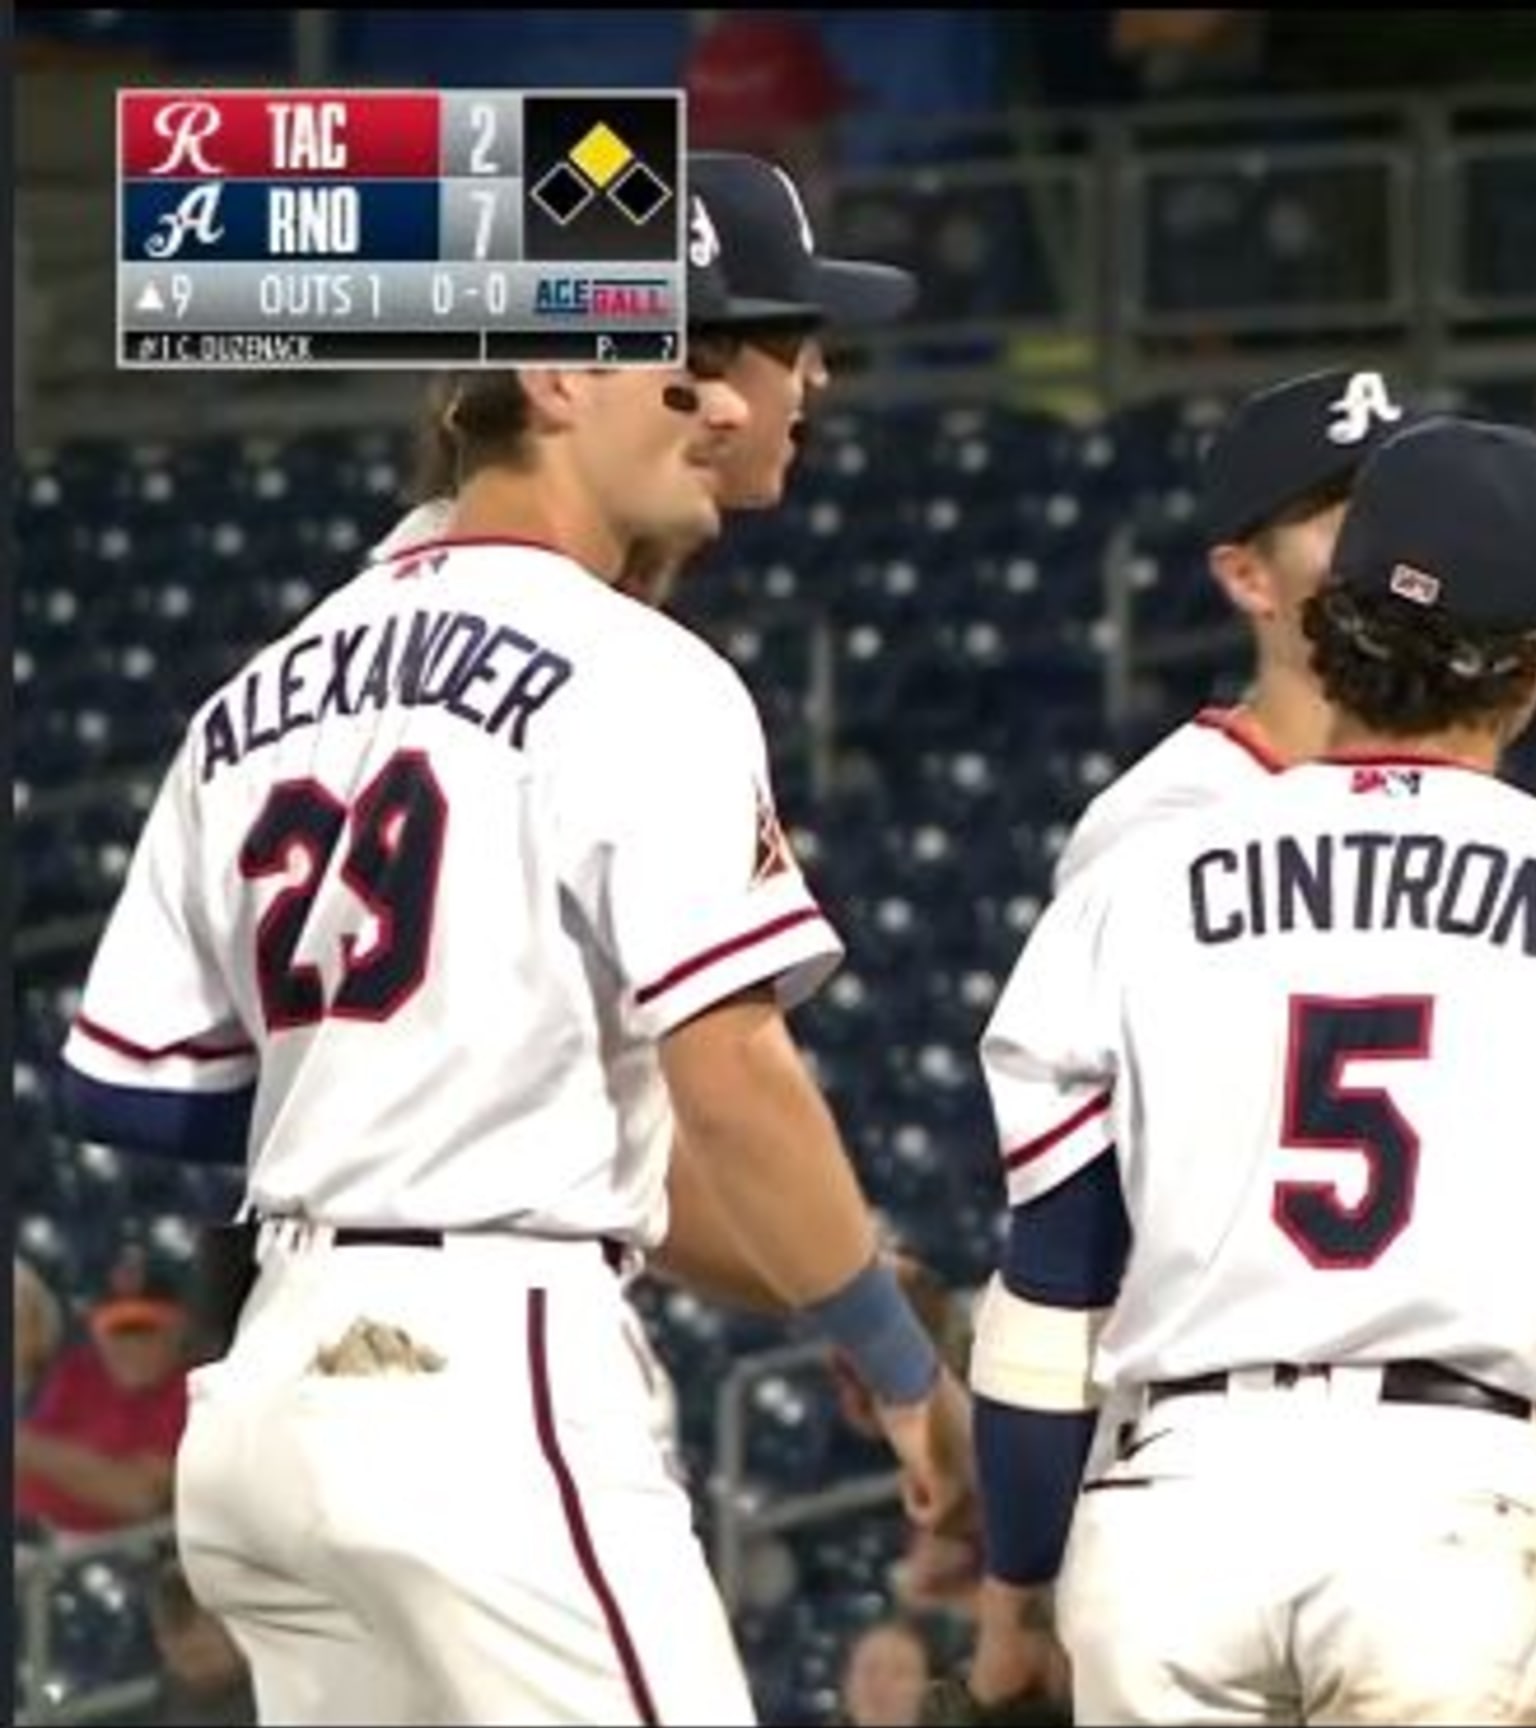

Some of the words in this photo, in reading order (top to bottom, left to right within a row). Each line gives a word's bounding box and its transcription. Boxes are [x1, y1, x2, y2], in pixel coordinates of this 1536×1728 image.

[202, 609, 574, 783] ALEXANDER
[238, 747, 450, 1034] 29
[1269, 993, 1437, 1271] 5
